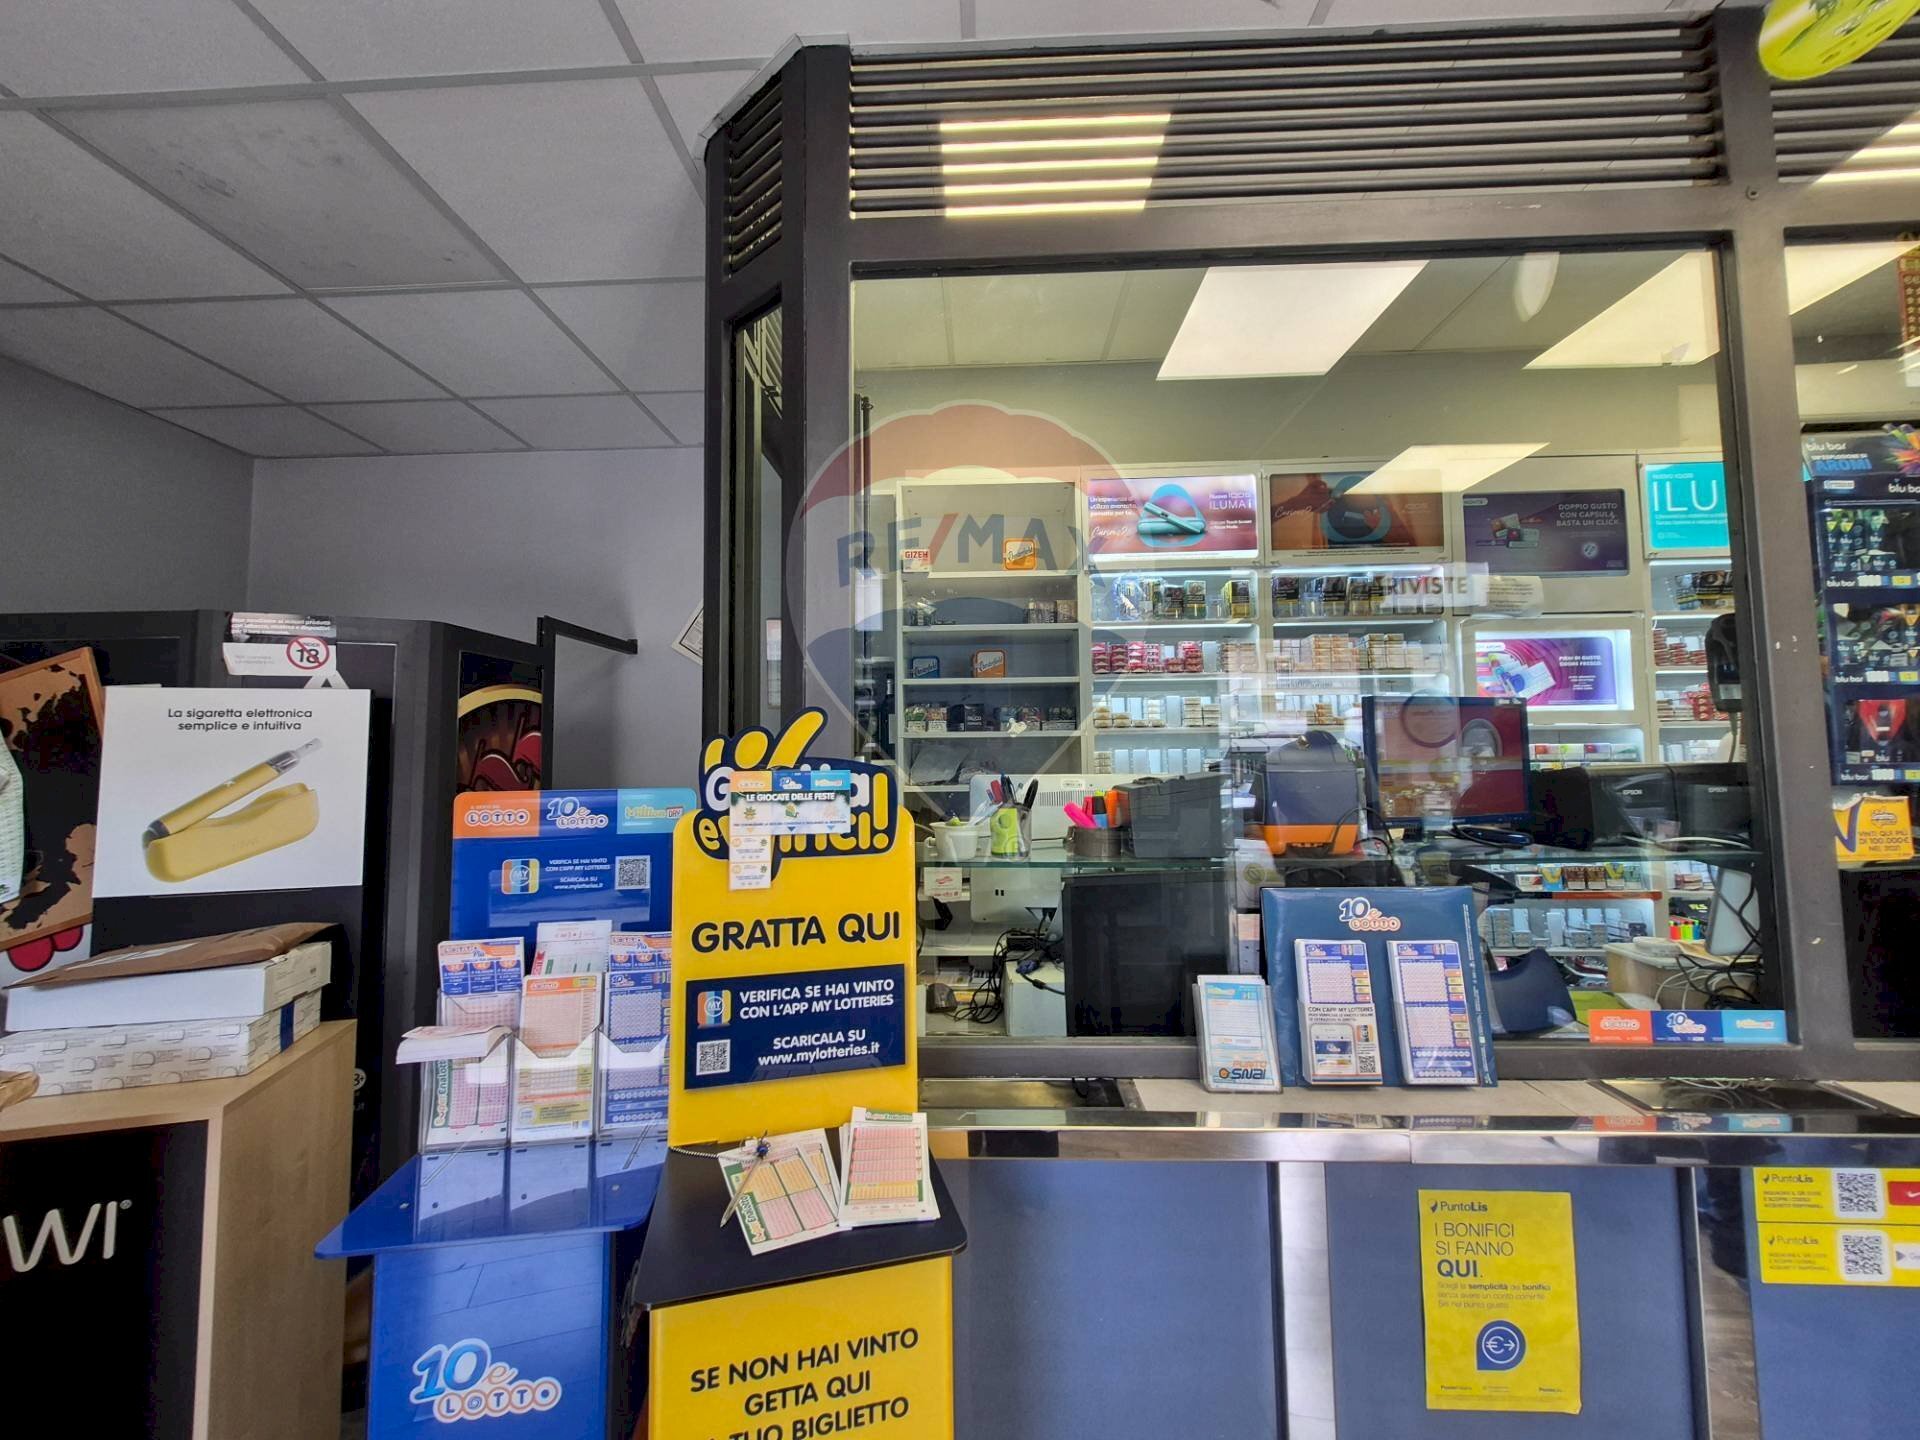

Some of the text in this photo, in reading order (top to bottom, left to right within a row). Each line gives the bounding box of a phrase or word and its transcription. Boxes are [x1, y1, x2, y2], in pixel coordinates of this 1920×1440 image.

[1815, 458, 1873, 472] AROMI
[1209, 499, 1247, 510] ILUMA
[1558, 502, 1618, 511] DOPPIO GUSTO
[1387, 576, 1468, 595] RIVISTE
[296, 648, 320, 664] 18
[168, 708, 313, 720] La sigaretta elettronica
[178, 721, 302, 731] semplice e intuitiva
[746, 792, 835, 802] LE GIOCATE DELLE FESTE
[465, 810, 530, 827] LOTTO
[556, 815, 608, 828] LOTTO
[691, 911, 900, 953] GRATTA QUI
[1349, 917, 1401, 931] LOTTO
[740, 979, 895, 1004] VERIFICA SE HAI VINTO
[707, 1000, 722, 1009] MY
[739, 994, 895, 1020] CON L'APP MY LOTTERIES
[773, 1028, 866, 1050] SCARICALA SU
[758, 1042, 880, 1066] www.mylotteries.it
[1440, 1200, 1488, 1212] PuntoLis
[1434, 1222, 1514, 1238] I BONIFICI
[1436, 1240, 1514, 1257] SI FANNO
[1437, 1259, 1483, 1278] QUI.
[1468, 1282, 1508, 1291] semplicità
[690, 1327, 919, 1393] SE NON HAI VINTO
[433, 1377, 562, 1423] LOTTO
[744, 1370, 871, 1416] GETTA QUI
[792, 1396, 910, 1440] BIGLIETTO
